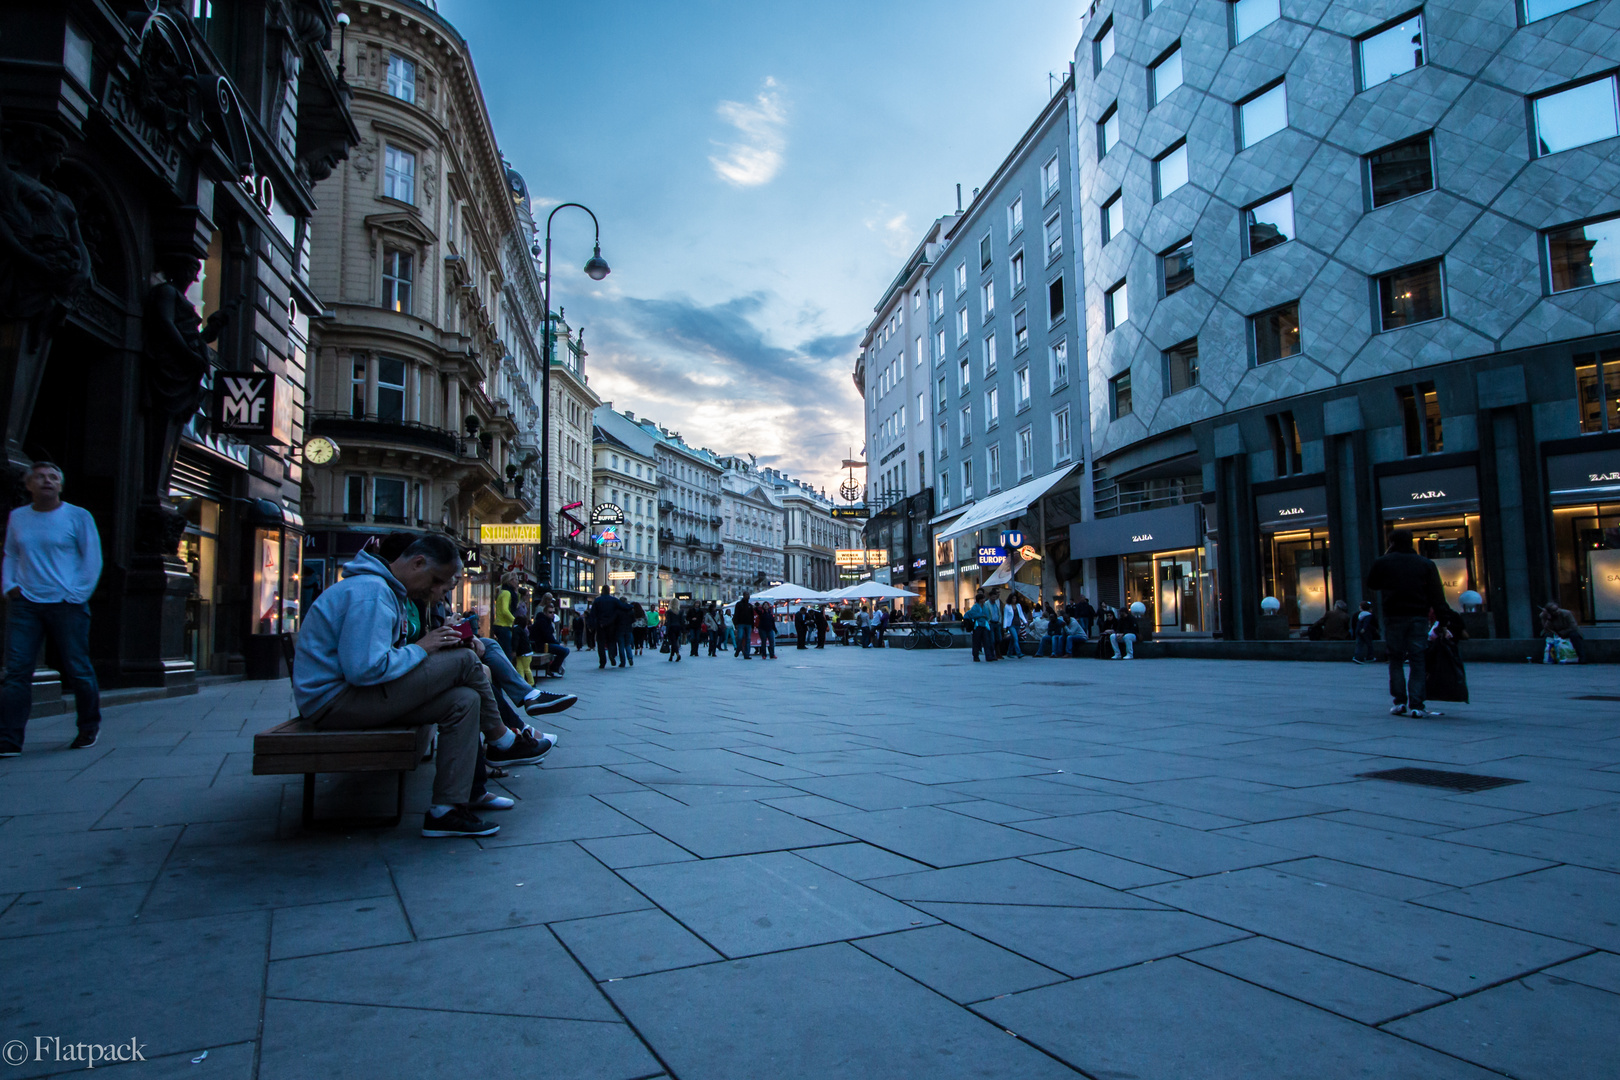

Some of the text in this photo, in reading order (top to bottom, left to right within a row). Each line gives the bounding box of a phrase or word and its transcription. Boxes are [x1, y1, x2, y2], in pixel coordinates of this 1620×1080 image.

[223, 377, 267, 424] WMF
[1588, 472, 1620, 482] ZAR
[1411, 490, 1446, 500] ZARA
[1279, 507, 1304, 516] ZARA
[1000, 534, 1006, 548] U
[1009, 533, 1021, 547] U
[1132, 534, 1153, 542] ZARA
[978, 548, 996, 556] CAFE
[1607, 574, 1620, 582] SA
